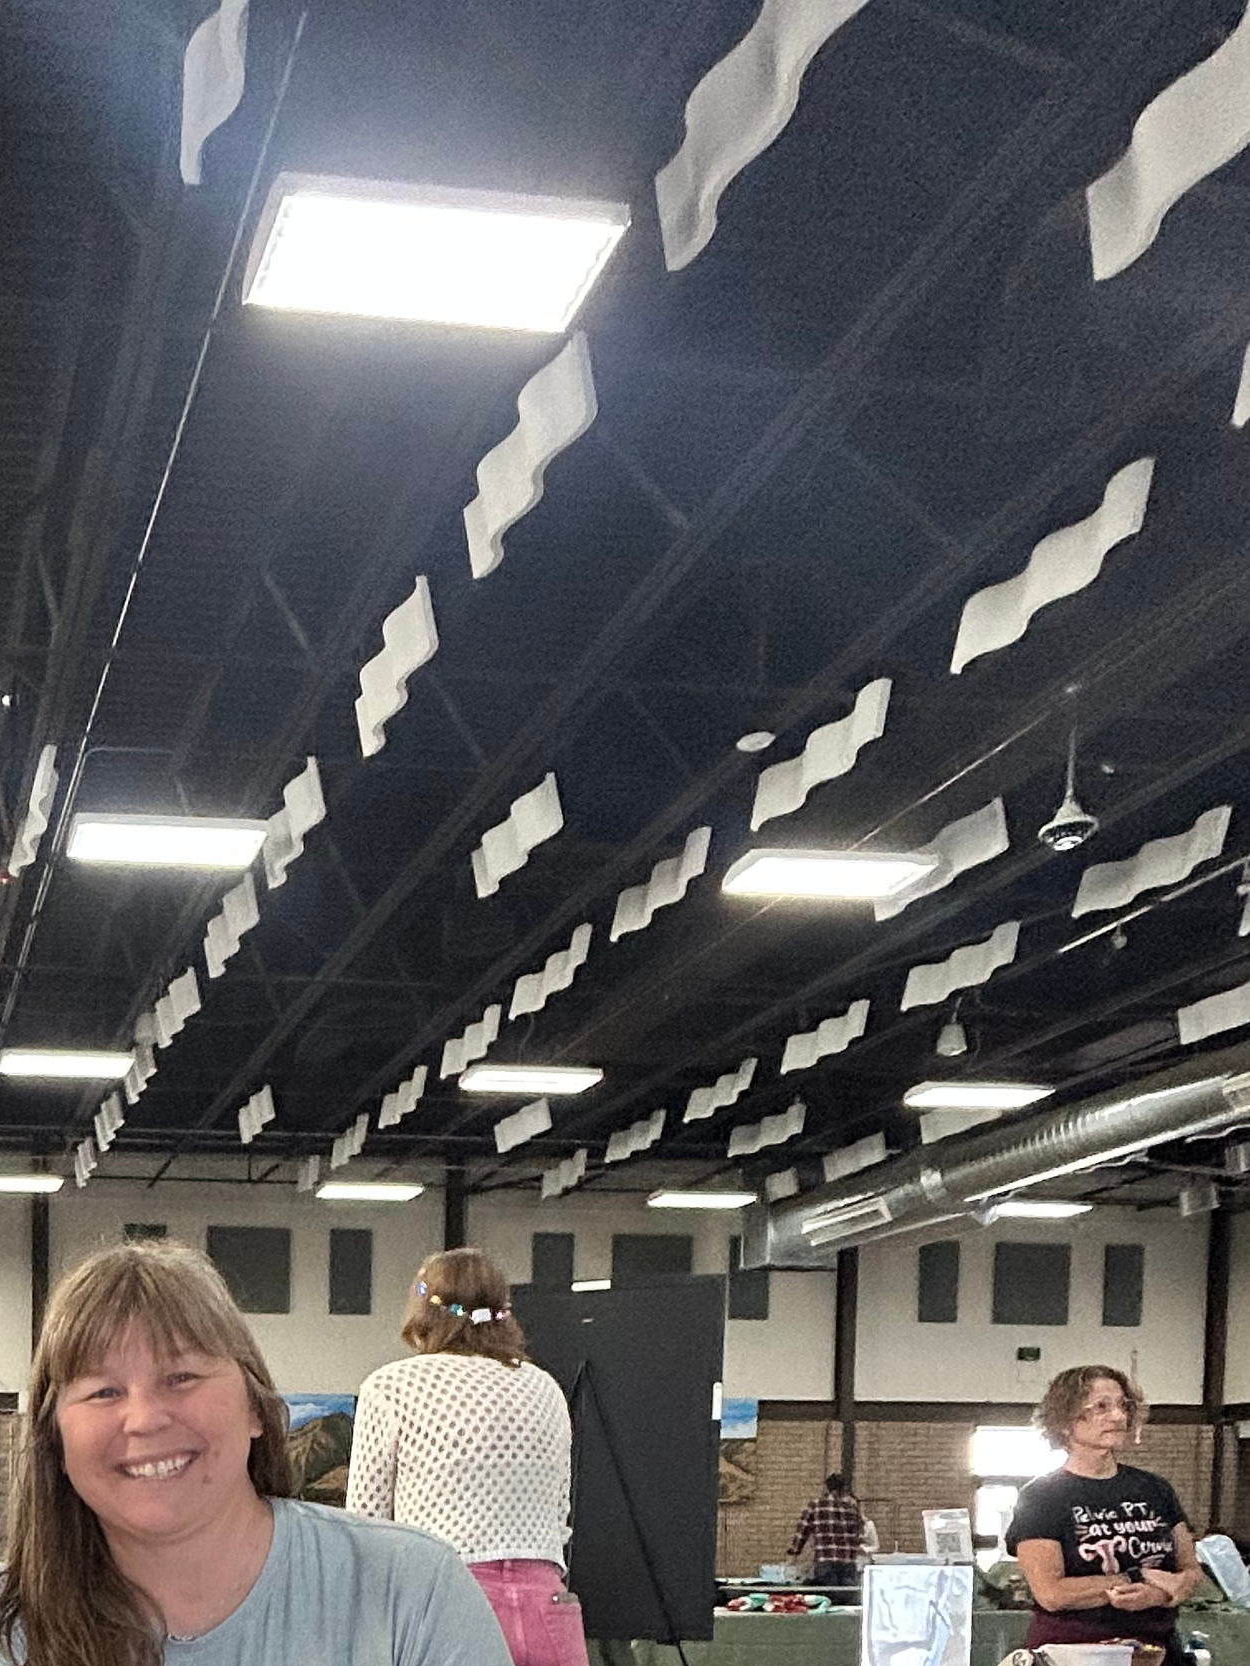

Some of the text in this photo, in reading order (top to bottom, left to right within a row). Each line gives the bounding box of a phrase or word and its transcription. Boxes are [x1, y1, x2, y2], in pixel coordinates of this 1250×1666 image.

[1072, 1506, 1117, 1523] Pelvic
[1089, 1519, 1157, 1536] at your
